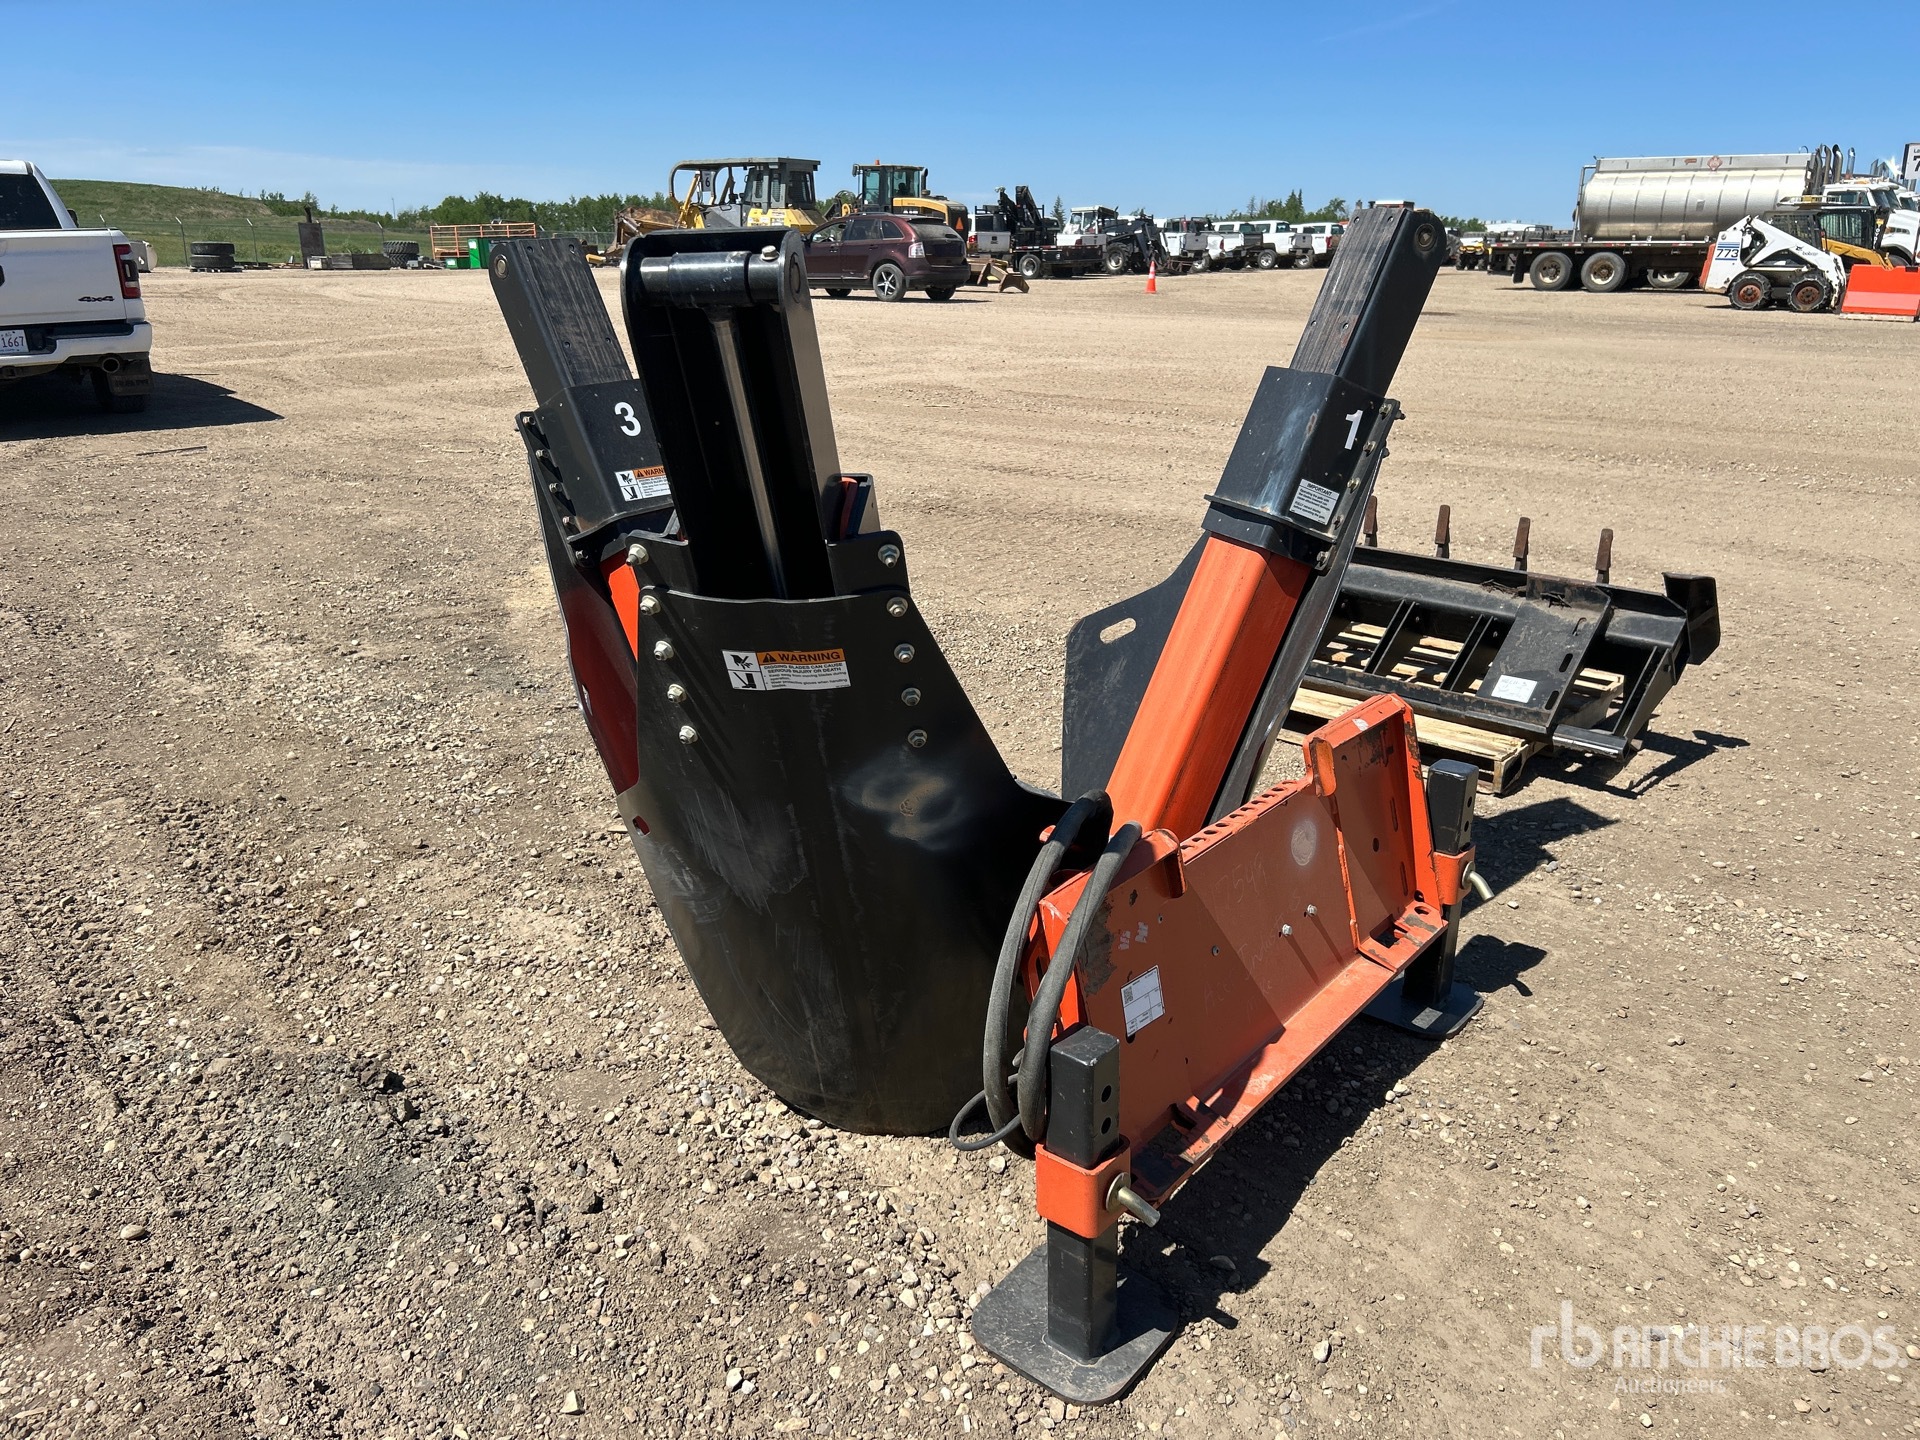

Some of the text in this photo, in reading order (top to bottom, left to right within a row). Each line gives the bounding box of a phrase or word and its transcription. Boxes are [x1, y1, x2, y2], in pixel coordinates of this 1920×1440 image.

[705, 175, 710, 188] 6
[1717, 248, 1739, 258] 773
[2, 336, 24, 348] 1667
[614, 402, 641, 436] 3
[1344, 410, 1363, 450] 1
[644, 468, 665, 476] WARN
[1307, 483, 1332, 496] IMPORTANT
[778, 652, 841, 662] WARNING
